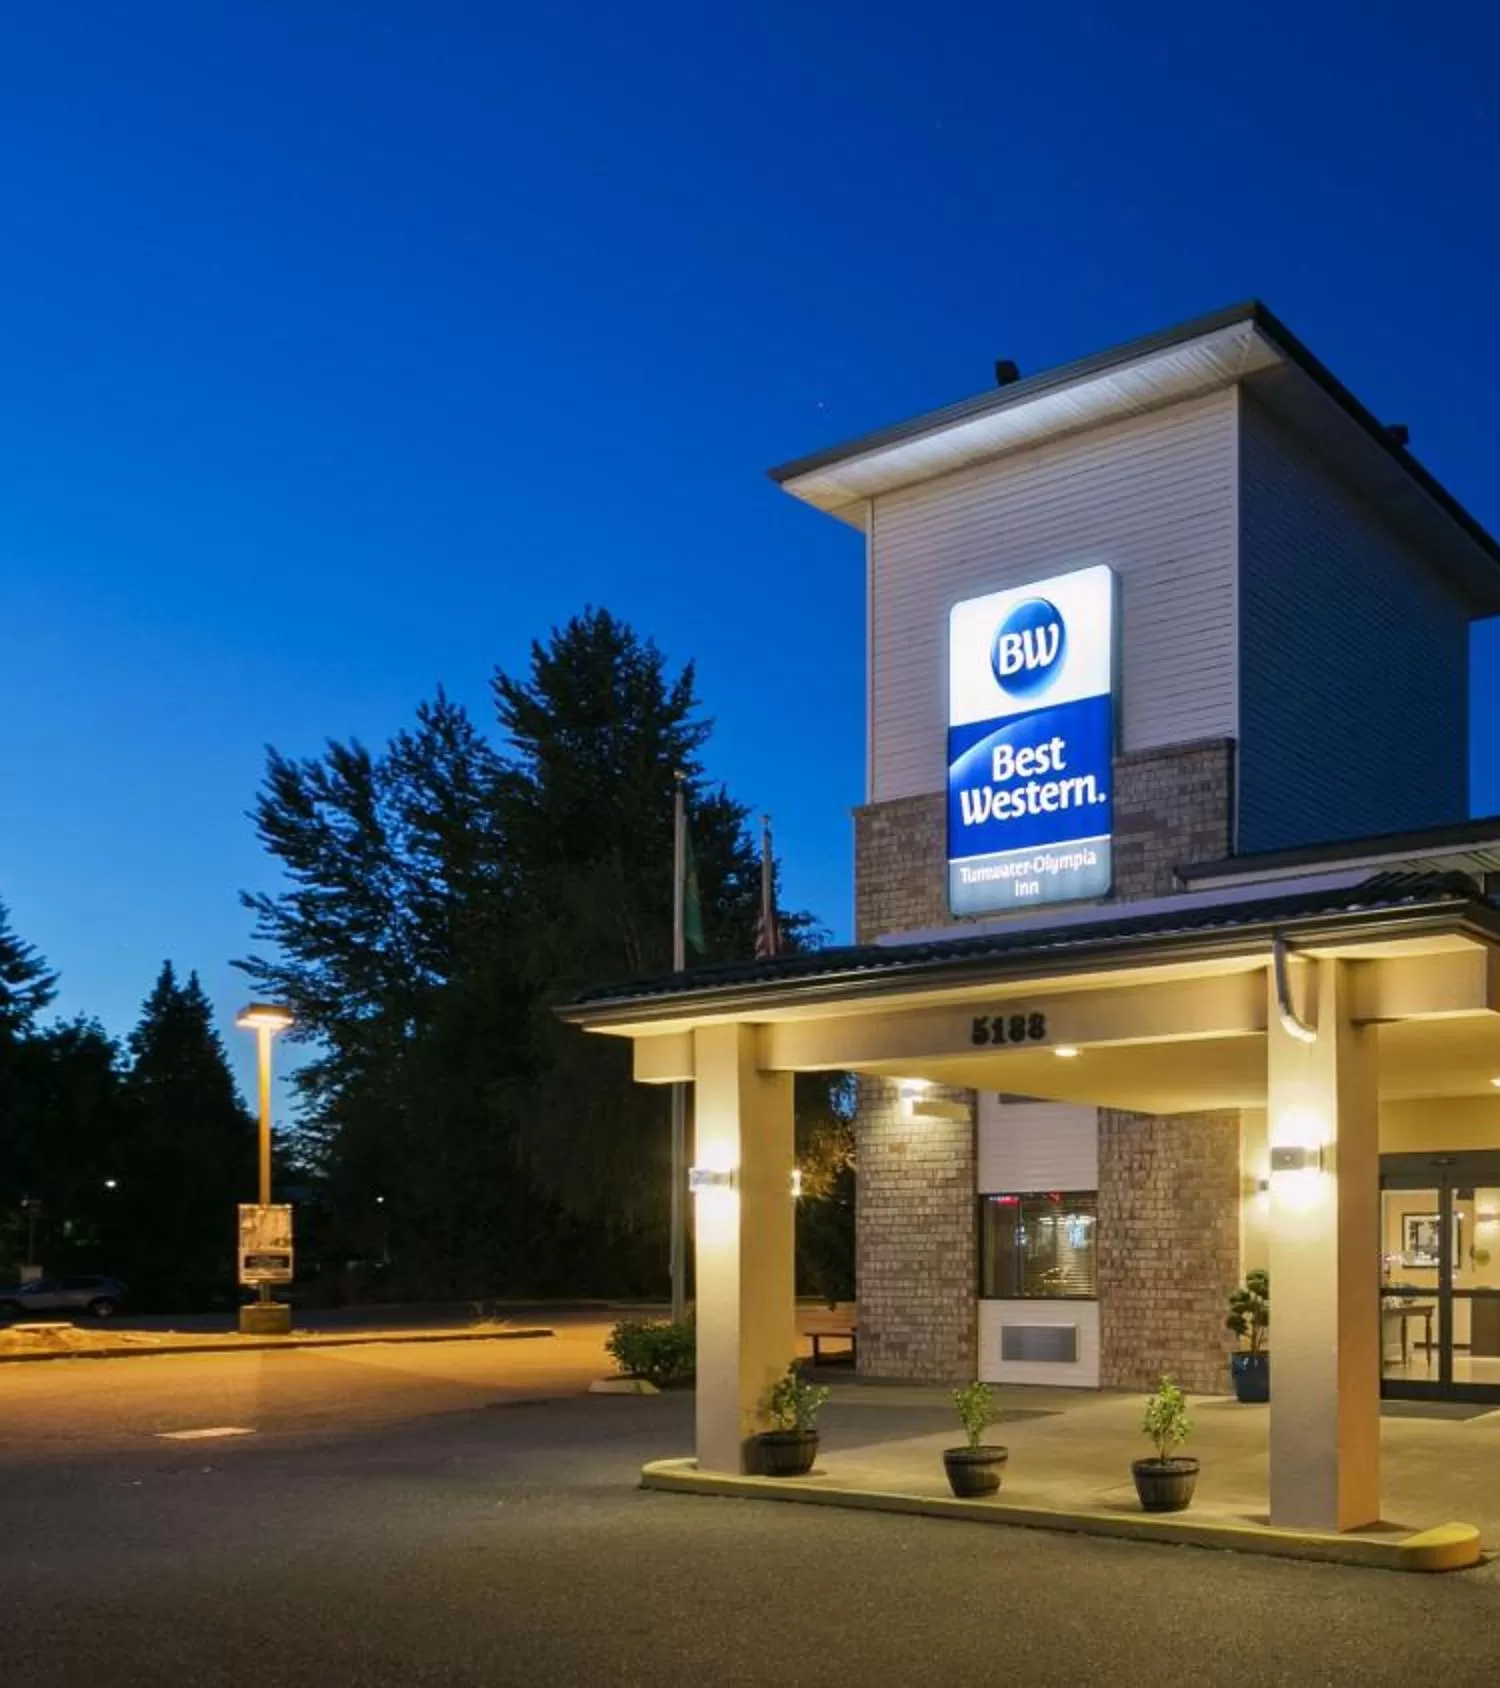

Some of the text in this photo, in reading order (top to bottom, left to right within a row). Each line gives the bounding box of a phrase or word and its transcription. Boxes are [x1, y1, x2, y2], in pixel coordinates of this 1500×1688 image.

[999, 622, 1059, 675] BW
[992, 736, 1066, 782] Best
[1015, 879, 1040, 897] Inn
[971, 1011, 1046, 1046] 5188
